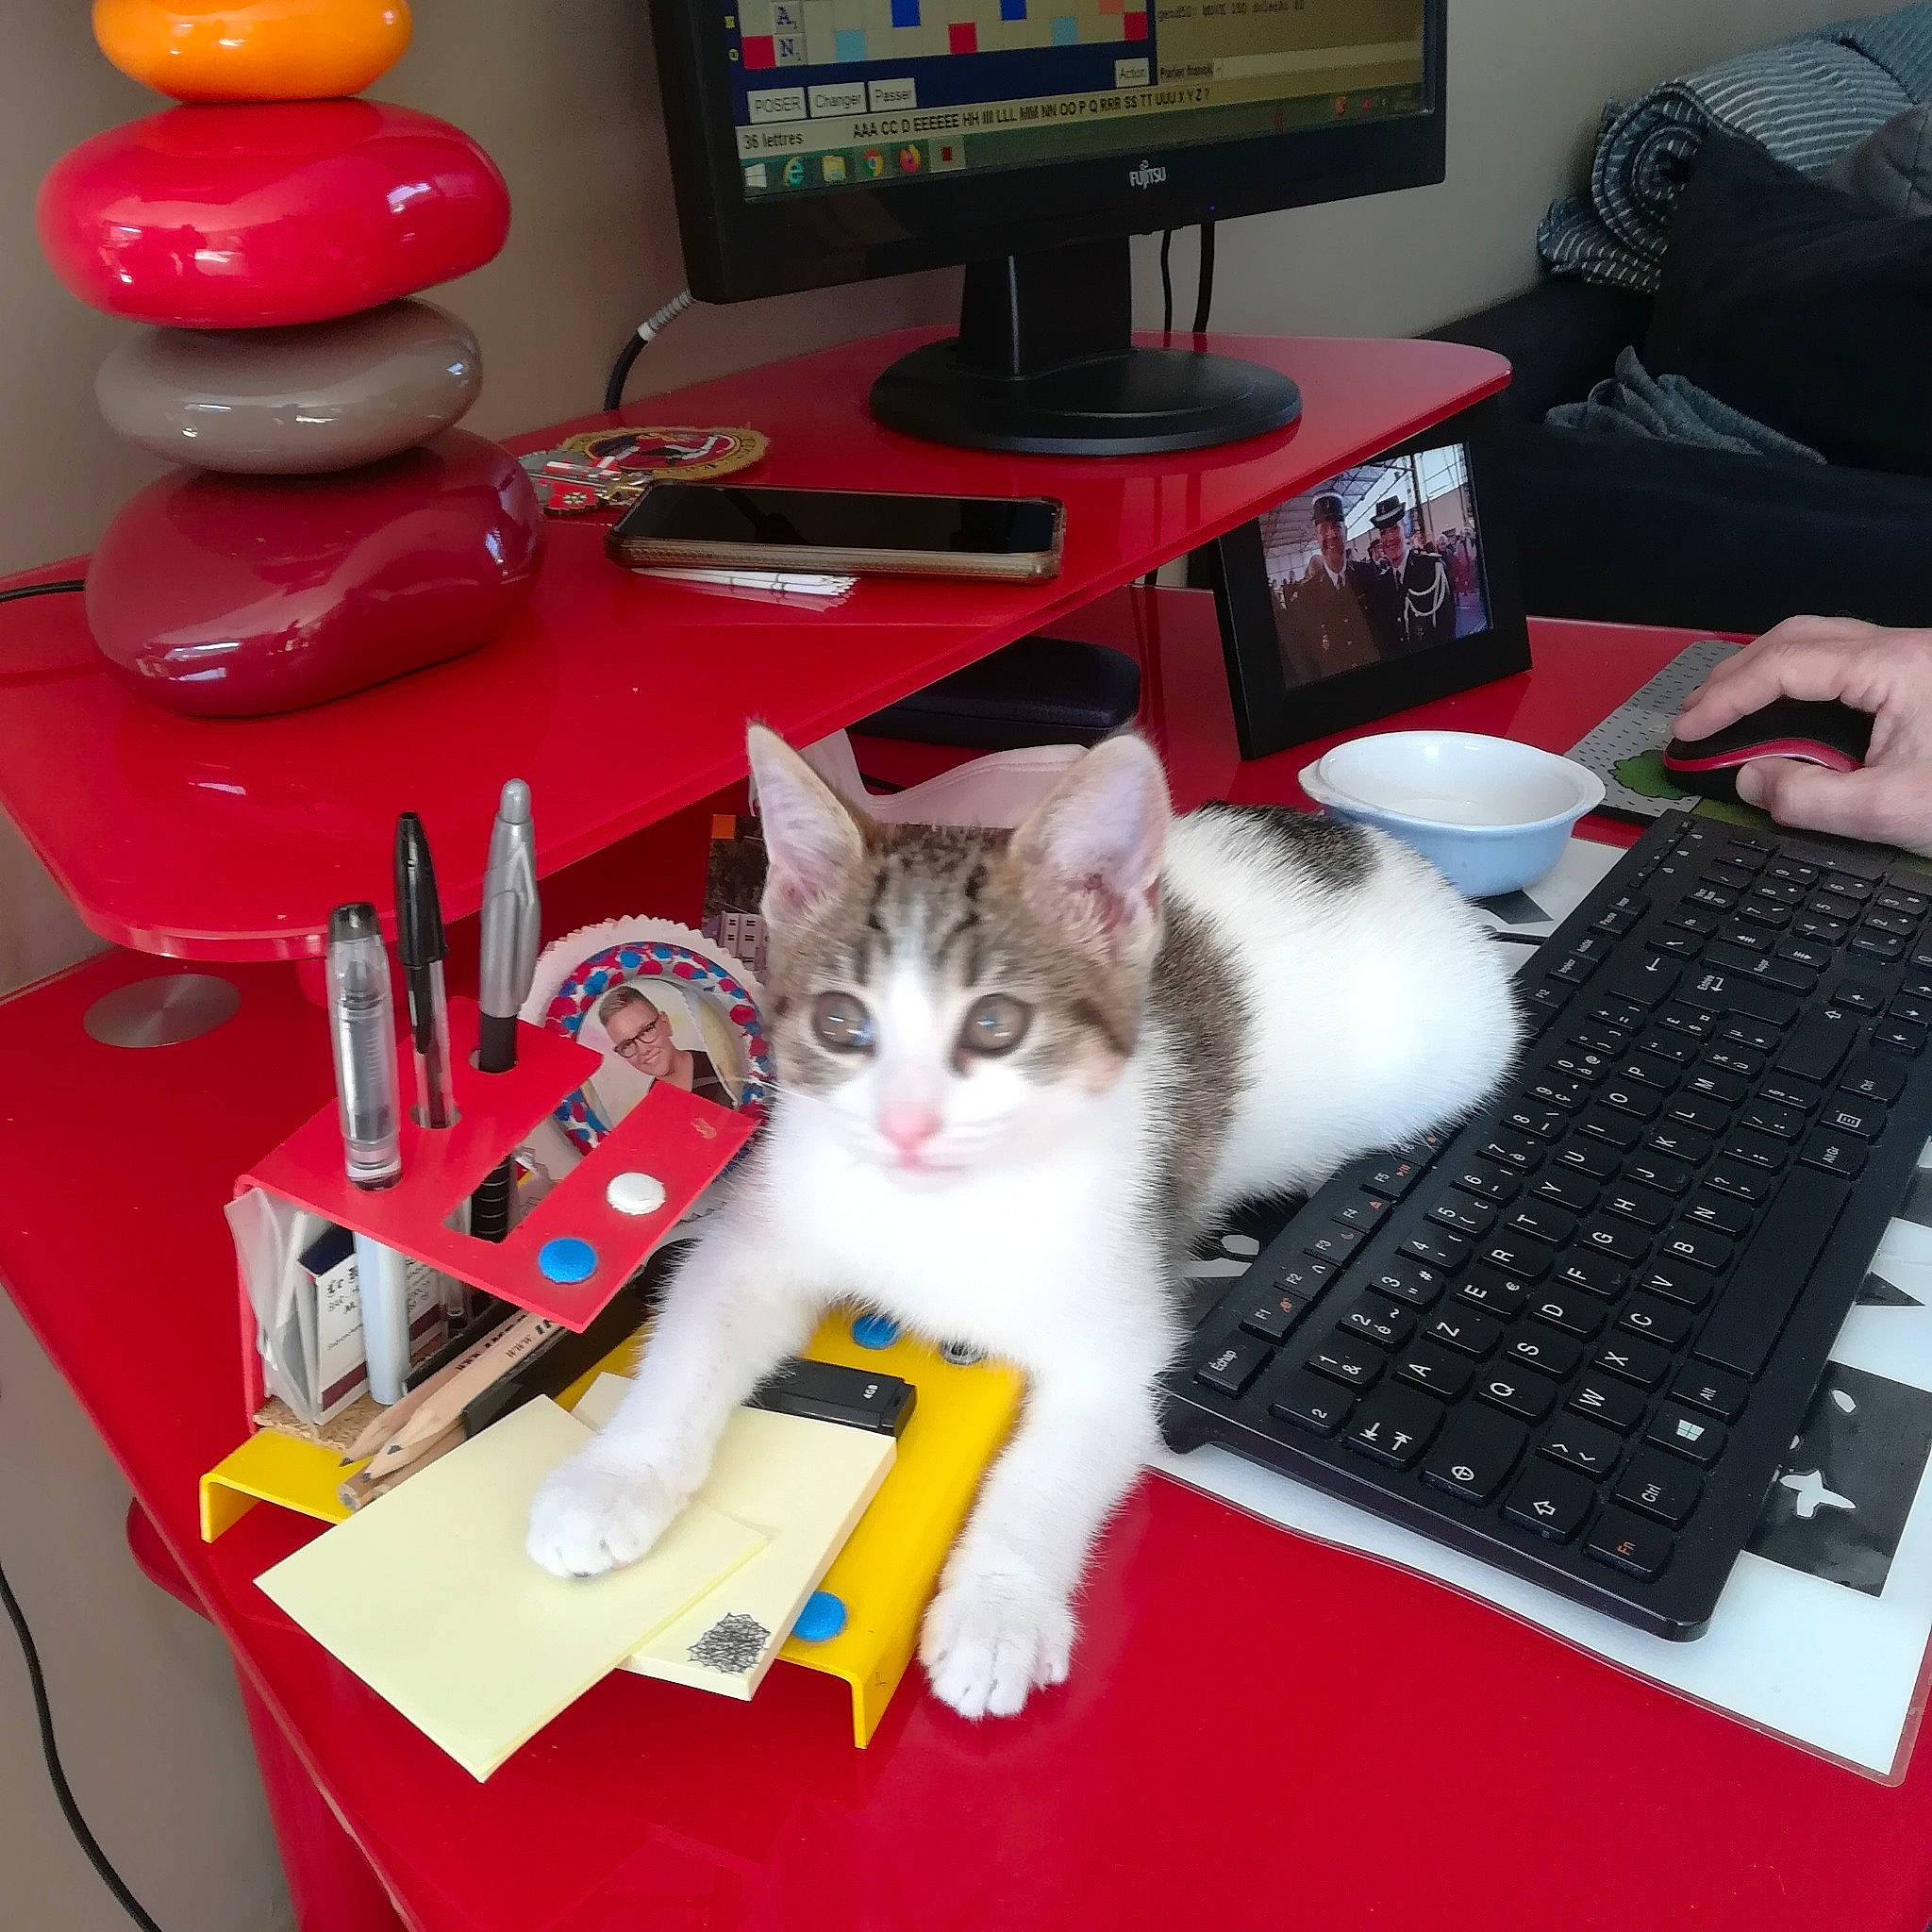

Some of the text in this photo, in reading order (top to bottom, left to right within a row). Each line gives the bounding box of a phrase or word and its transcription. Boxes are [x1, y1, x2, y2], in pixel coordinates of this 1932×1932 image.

[815, 93, 862, 110] Changer
[875, 89, 912, 104] Passer
[755, 96, 802, 112] POSER
[853, 122, 877, 139] AAA
[881, 120, 898, 135] CC
[902, 119, 910, 133] D
[962, 112, 980, 128] HH
[1079, 101, 1086, 114] P
[1125, 95, 1138, 108] SS
[1141, 93, 1153, 107] TT
[762, 132, 804, 147] lettres
[1129, 167, 1167, 190] FUJITSU
[1627, 1067, 1644, 1076] P
[1694, 1078, 1715, 1090] M
[1609, 1093, 1627, 1103] O
[1675, 1110, 1695, 1119] L
[1656, 1136, 1676, 1147] K
[1489, 1143, 1505, 1153] 7
[1564, 1151, 1585, 1162] U
[1374, 1173, 1390, 1182] F5
[1637, 1168, 1655, 1177] J
[1464, 1175, 1481, 1184] 6
[1541, 1181, 1561, 1191] Y
[1614, 1196, 1636, 1210] H
[1343, 1208, 1358, 1218] F4
[1438, 1207, 1457, 1218] 5
[1694, 1207, 1716, 1219] N
[1517, 1214, 1537, 1224] T
[1592, 1232, 1613, 1243] G
[1315, 1241, 1331, 1250] F3
[1412, 1241, 1429, 1250] 4
[1673, 1242, 1694, 1253] B
[1491, 1250, 1514, 1261] R
[1286, 1274, 1303, 1284] F2
[1565, 1268, 1586, 1280] F
[1382, 1276, 1400, 1287] 3
[1651, 1274, 1673, 1287] V
[1464, 1285, 1487, 1298] E
[1255, 1308, 1271, 1320] F1
[1541, 1305, 1563, 1317] D
[1350, 1314, 1372, 1325] 2
[1630, 1313, 1652, 1327] C
[1437, 1322, 1460, 1337] Z
[1517, 1342, 1539, 1355] S
[1208, 1351, 1238, 1371] Échap
[1319, 1354, 1338, 1364] 1
[1605, 1351, 1628, 1366] X
[1341, 1362, 1362, 1374] &
[1408, 1364, 1431, 1377] A
[1490, 1383, 1515, 1396] Q
[1700, 1388, 1716, 1401] Alt
[1579, 1389, 1605, 1407] W
[1641, 1484, 1663, 1502] Ctrl
[1617, 1541, 1636, 1556] Fn
